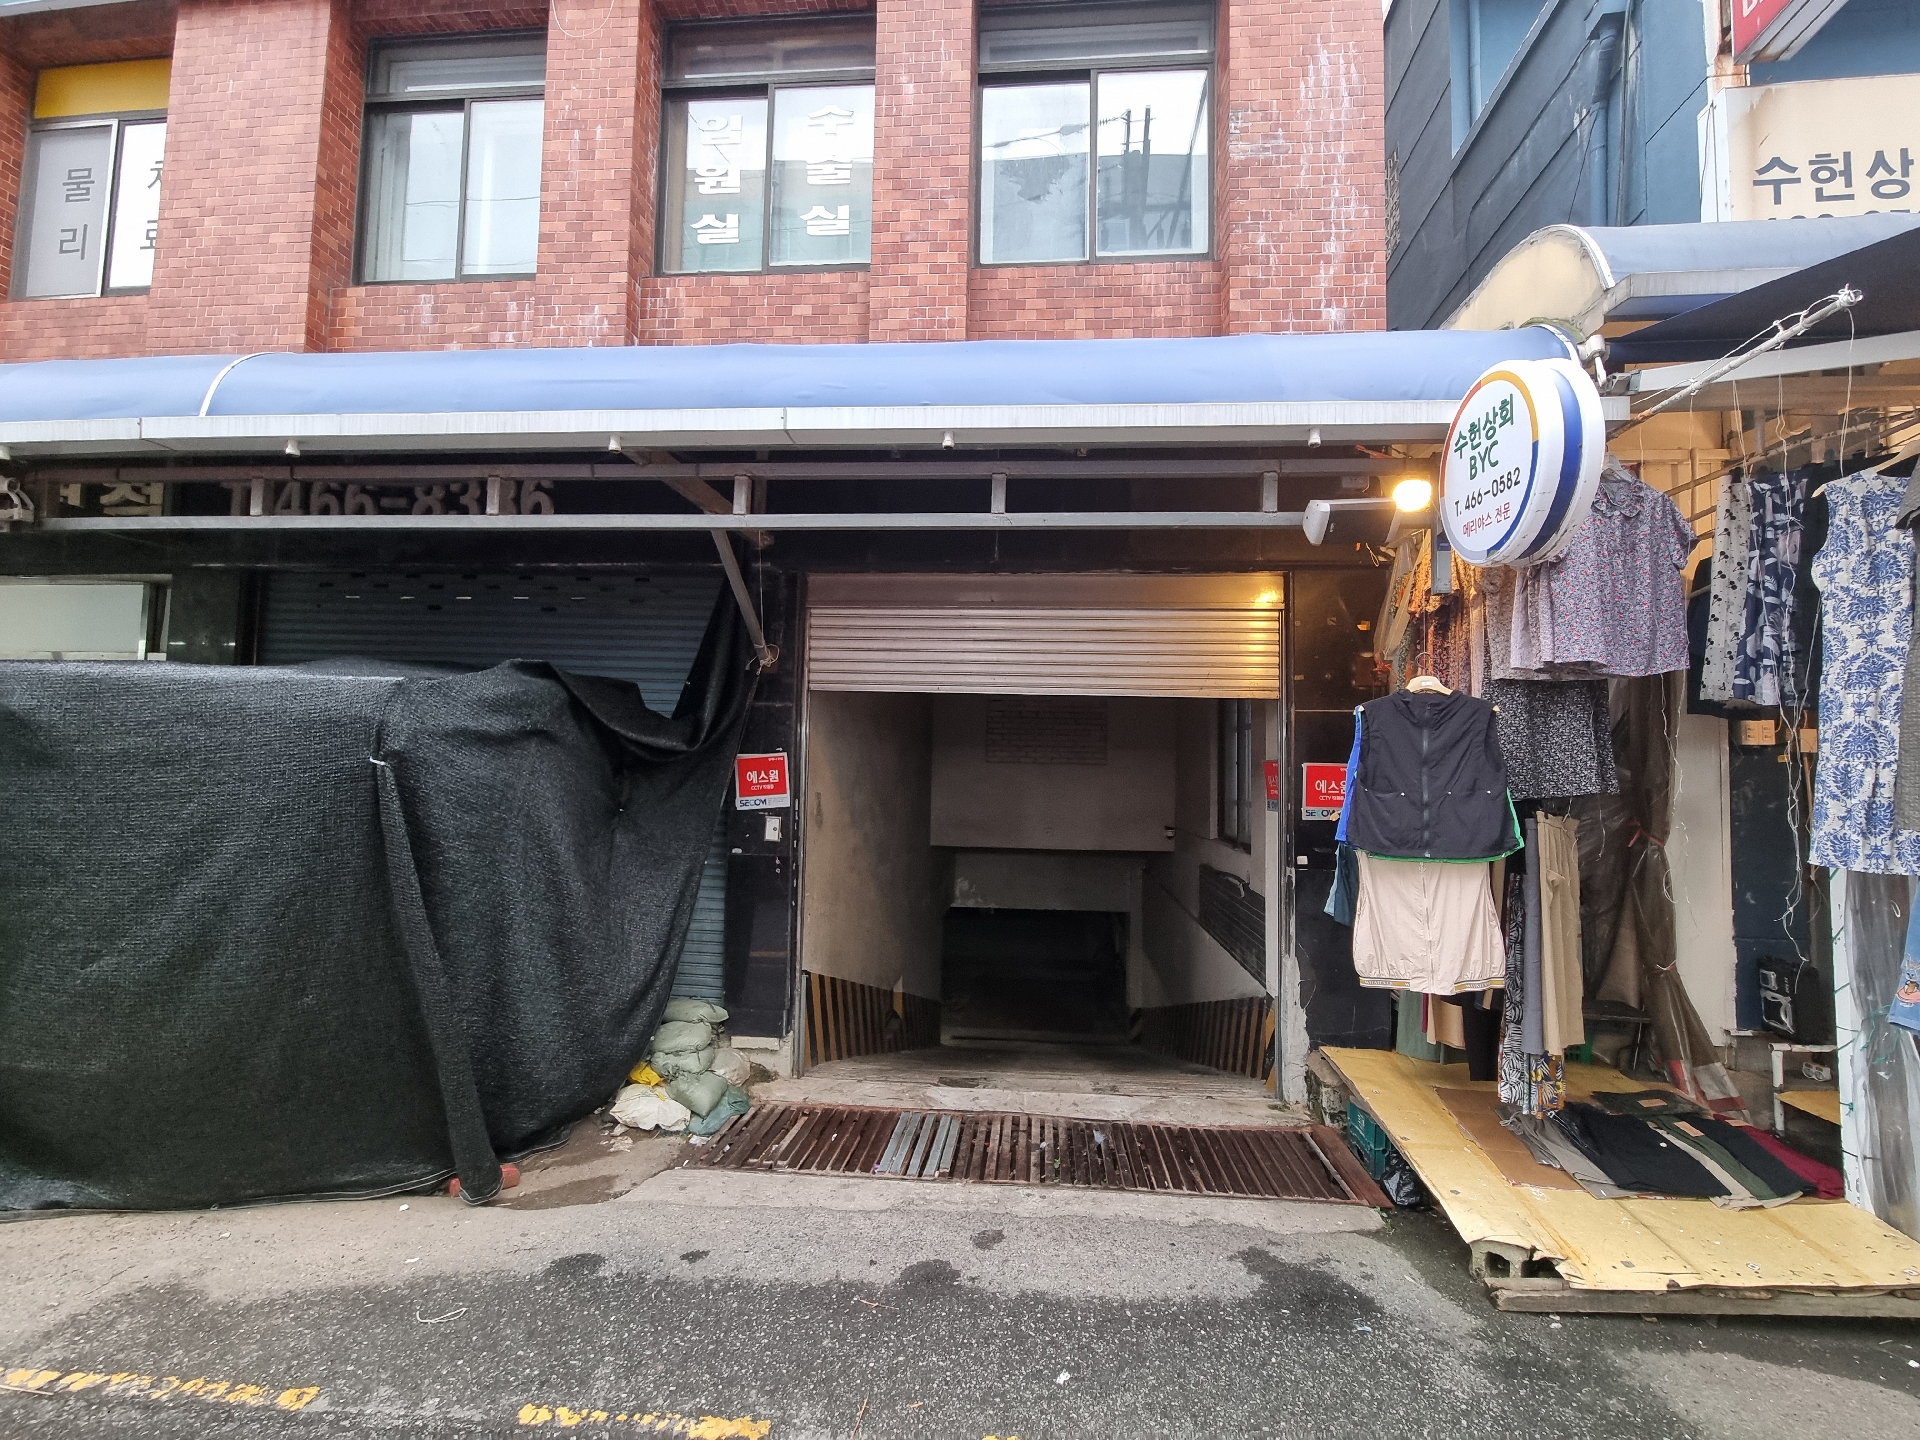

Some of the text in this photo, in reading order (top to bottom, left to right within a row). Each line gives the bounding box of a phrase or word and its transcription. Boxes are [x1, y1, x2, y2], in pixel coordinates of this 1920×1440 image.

[800, 105, 854, 236] 수술실
[1753, 148, 1915, 205] 수헌상
[59, 168, 95, 261] 물리
[1453, 393, 1514, 460] 수헌상회
[1469, 440, 1499, 481] BYC
[1454, 466, 1521, 518] T. 466-0582
[1463, 502, 1511, 537] 메리야스 전문
[746, 769, 779, 783] 에스원
[740, 799, 767, 807] SECOM
